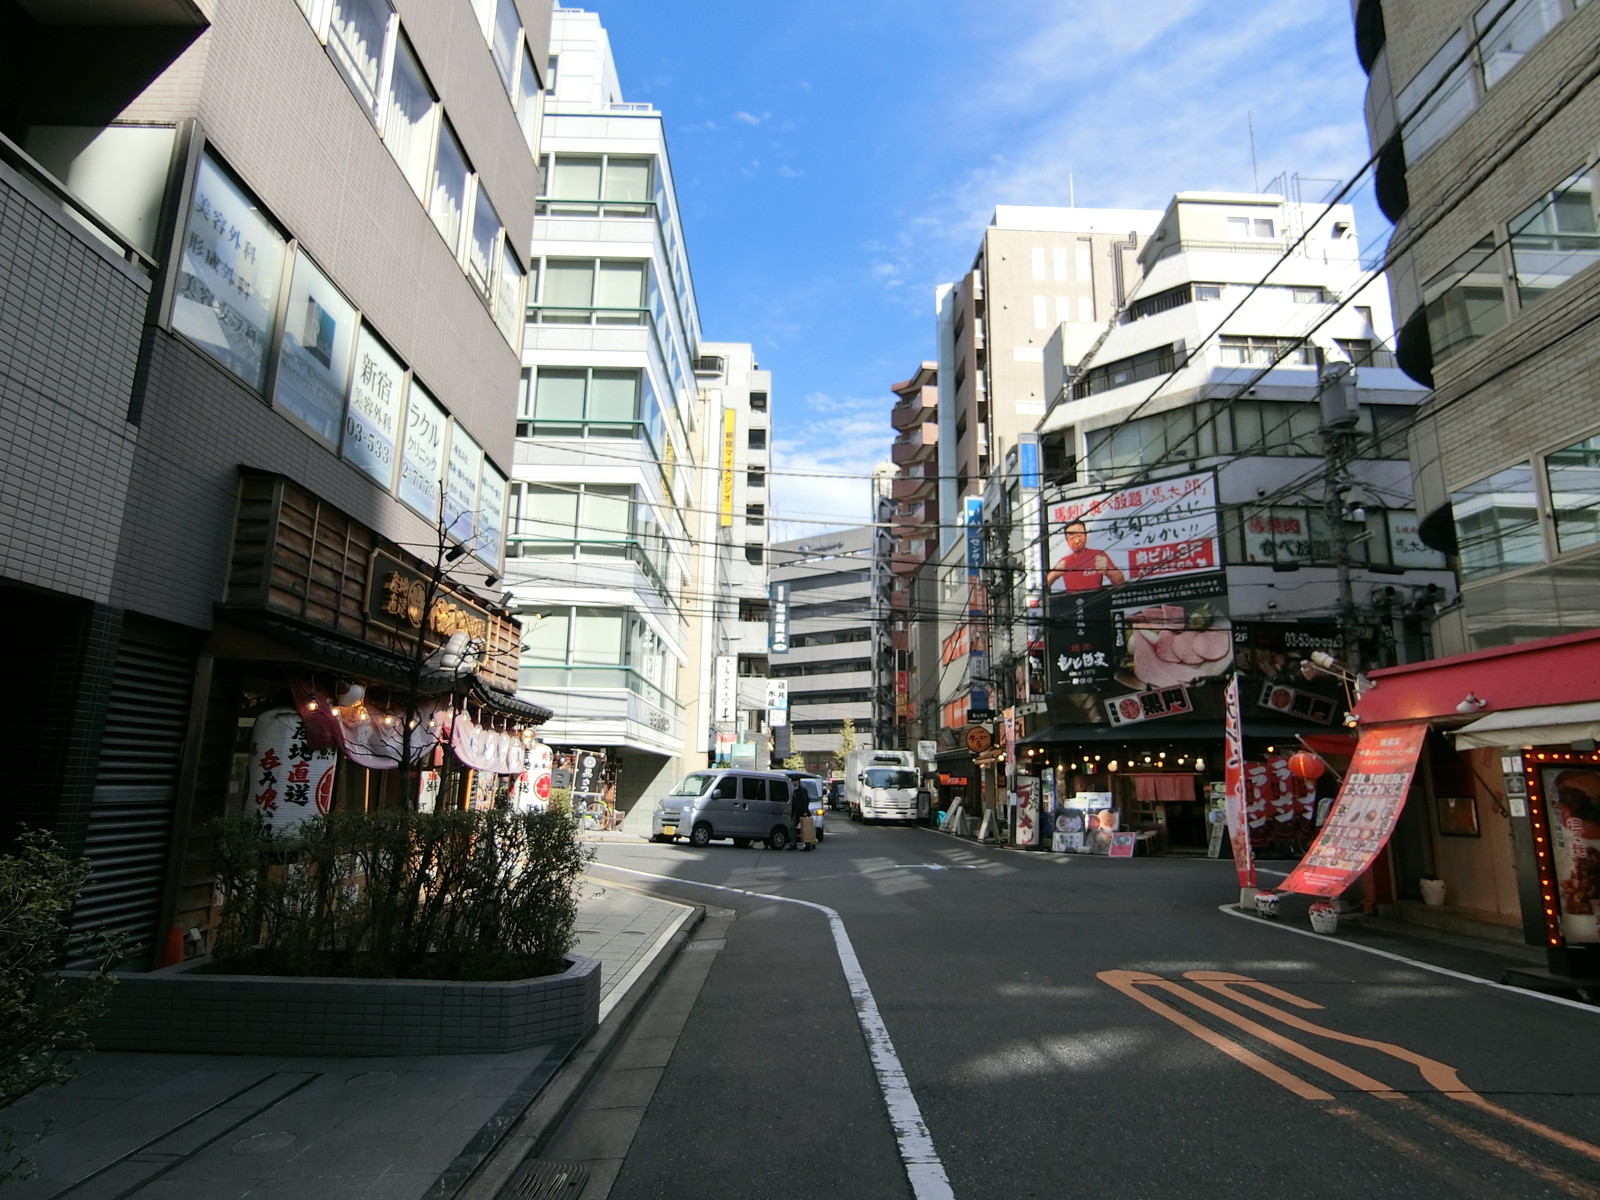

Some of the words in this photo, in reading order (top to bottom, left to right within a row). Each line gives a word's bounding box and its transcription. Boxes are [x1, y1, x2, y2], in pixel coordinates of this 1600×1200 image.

[195, 193, 256, 265] 美容外科
[352, 387, 392, 435] 美容外科
[407, 435, 437, 473] クリニック
[360, 352, 392, 406] 新宿
[410, 402, 440, 448] ラクル
[346, 416, 389, 464] 03-533
[402, 461, 436, 502] 2-7773
[724, 431, 733, 502] 新宿マイスタジオ
[969, 538, 981, 568] センター
[1234, 632, 1248, 643] 2F
[1017, 784, 1034, 845] ラーメン
[1246, 766, 1267, 829] ラーメン
[1271, 760, 1294, 823] ラーメン
